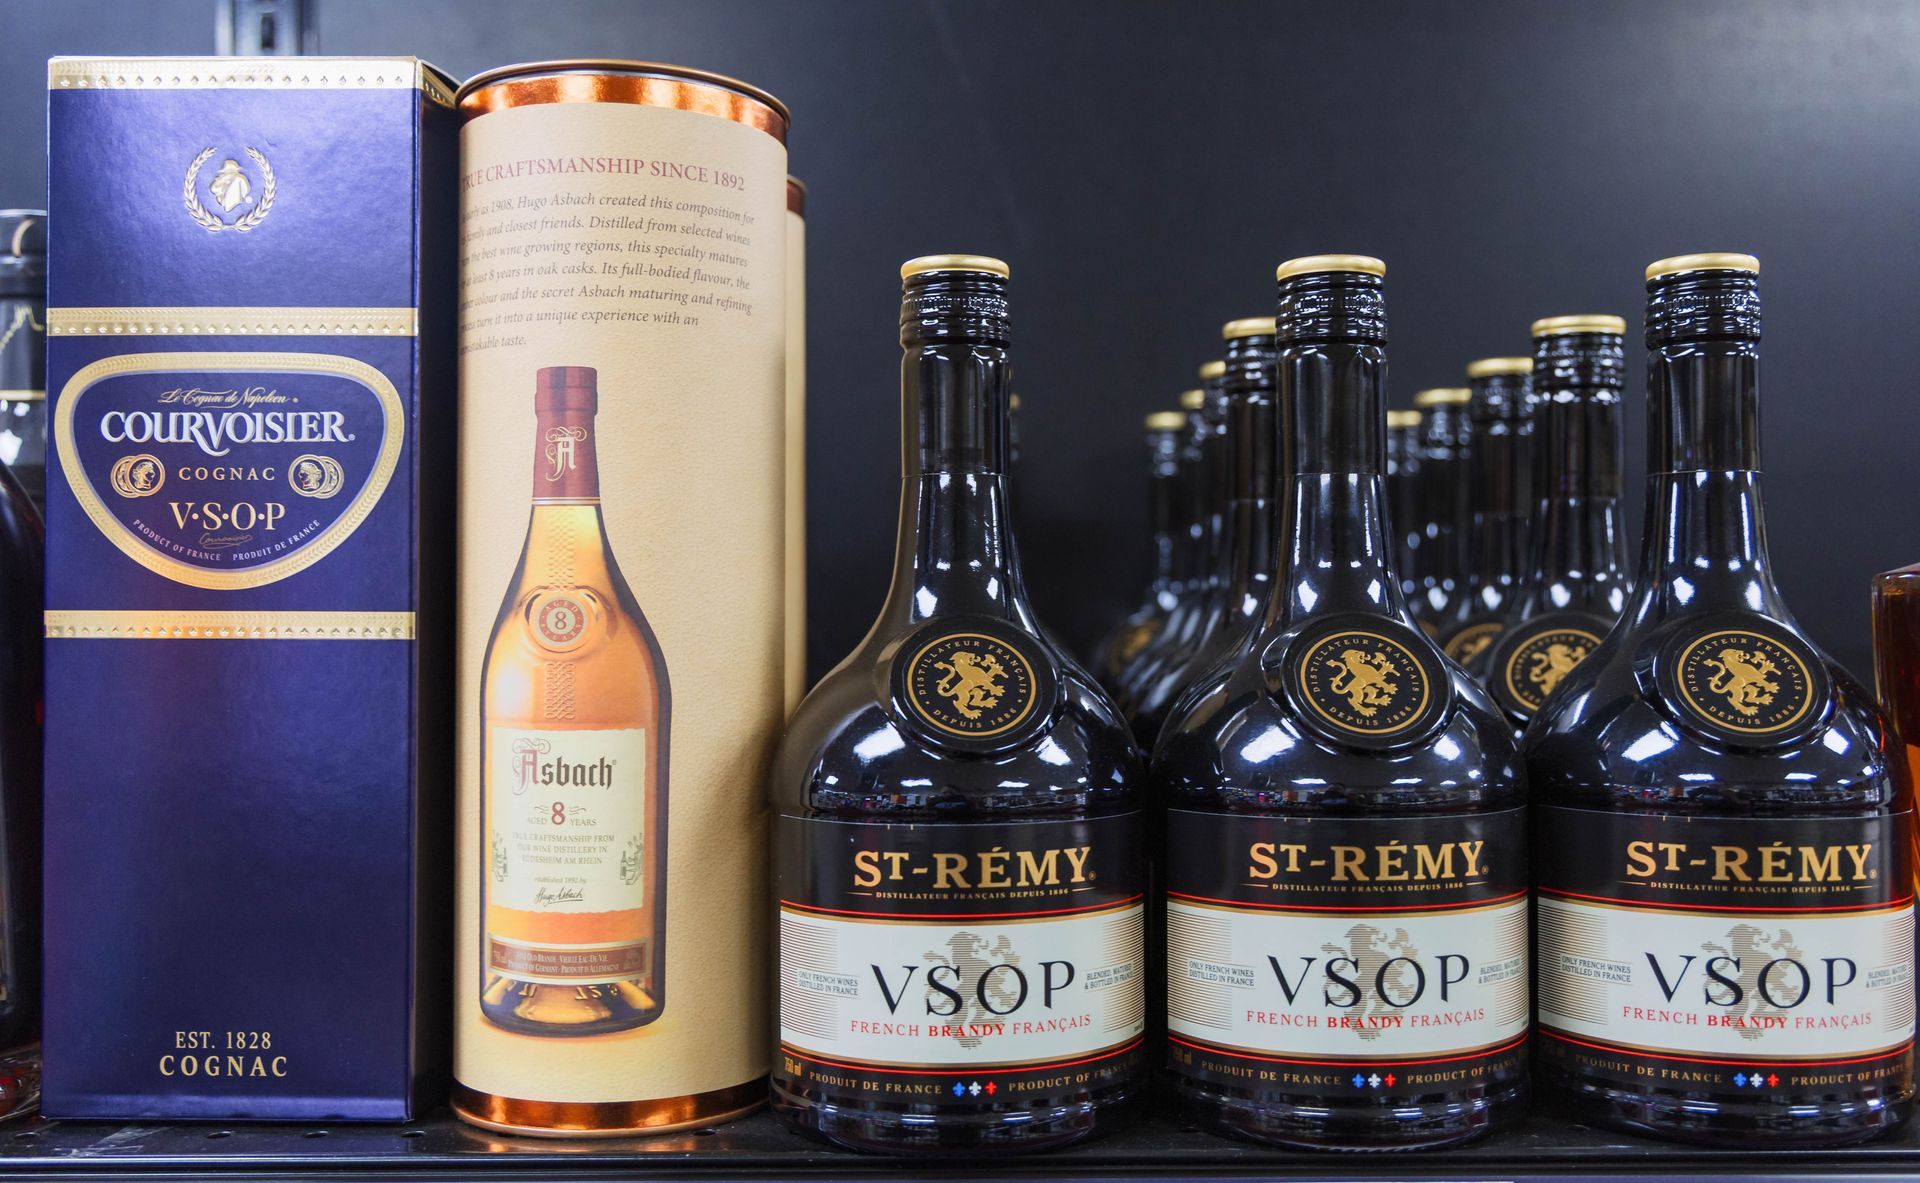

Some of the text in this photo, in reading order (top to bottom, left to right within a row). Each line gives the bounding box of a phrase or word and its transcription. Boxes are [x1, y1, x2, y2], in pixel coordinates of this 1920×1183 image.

[486, 157, 745, 190] CRAFTSMANSHIP SINCE 1892
[518, 195, 547, 211] Hugo
[551, 193, 594, 206] Asbach
[599, 194, 647, 208] created
[650, 196, 672, 210] this
[676, 200, 741, 222] composition
[742, 213, 755, 226] for
[487, 216, 750, 246] and closest friends. Distilled from selected wines
[500, 244, 521, 256] wine
[524, 240, 571, 257] growing
[575, 240, 623, 255] regions,
[628, 240, 651, 253] this
[655, 244, 706, 262] specialty
[708, 251, 748, 267] matures
[496, 267, 520, 283] years
[524, 264, 534, 276] in
[537, 262, 558, 275] oak
[562, 261, 597, 274] casks.
[602, 262, 617, 274] Its
[619, 262, 690, 280] full-bodied
[692, 269, 733, 287] flavour,
[736, 276, 750, 290] the
[500, 285, 752, 316] and the secret Asbach maturing and refining
[504, 312, 523, 323] into
[537, 309, 577, 324] unique
[581, 309, 649, 324] experience
[653, 310, 680, 324] with
[683, 317, 698, 326] an
[501, 336, 526, 347] taste.
[101, 411, 348, 456] COURVOISIER
[178, 468, 275, 481] COGNAC
[133, 519, 221, 561] PRODUCT OF FRANCE
[233, 520, 321, 560] PRODUIT DE FRANCE
[555, 611, 566, 630] 8
[917, 641, 1027, 696] DISTILLATEUR FRANÇAIS
[1310, 639, 1420, 693] DISTILLATEUR FRANÇAIS
[1688, 638, 1802, 692] DISTILLATEUR FRANÇAIS
[933, 709, 982, 728] DEPUIS
[1329, 706, 1378, 726] DEPUIS
[1709, 706, 1760, 724] DEPUIS
[512, 738, 612, 795] Asbach
[552, 802, 565, 825] 8
[599, 845, 608, 854] IN
[1250, 840, 1484, 881] ST-RÉMY
[854, 847, 1091, 888] ST-RÉMY
[1626, 841, 1872, 882] ST-RÉMY
[876, 891, 948, 900] DISTILLATEUR
[954, 892, 1006, 900] FRANÇAIS
[1010, 889, 1045, 898] DEPUIS
[1272, 883, 1347, 892] DISTILLATEUR
[1352, 884, 1403, 893] FRANÇAIS
[1408, 882, 1441, 891] DEPUIS
[1650, 881, 1728, 892] DISTILLATEUR
[1189, 961, 1254, 977] ONLY FRENCH WINES
[1562, 956, 1631, 974] ONLY FRENCH WINES
[1562, 964, 1592, 976] DISTILLED
[1602, 972, 1631, 982] FRANCE
[813, 974, 858, 986] FRENCH WINES
[871, 960, 1075, 1016] VSOP
[1189, 970, 1217, 980] DISTILLED
[1227, 976, 1254, 986] FRANCE
[1267, 953, 1470, 1008] VSOP
[1645, 952, 1857, 1009] VSOP
[833, 986, 858, 995] FRANCE
[850, 1014, 1092, 1037] FRENCH BRANDY FRANÇAIS
[1246, 1007, 1485, 1029] FRENCH BRANDY FRANÇAIS
[1623, 1005, 1872, 1031] FRENCH BRANDY FRANÇAIS
[176, 1031, 271, 1049] EST. 1828
[160, 1055, 287, 1077] COGNAC
[1202, 1060, 1342, 1085] PRODUIT DE FRANCE
[1407, 1066, 1485, 1085] PRODUCT OF
[1575, 1054, 1722, 1083] PRODUIT DE FRANCE
[809, 1072, 942, 1094] PRODUIT DE FRANCE
[1008, 1073, 1089, 1092] PRODUCT OF
[1791, 1074, 1853, 1085] PRODUCT
[1857, 1071, 1870, 1081] OF
